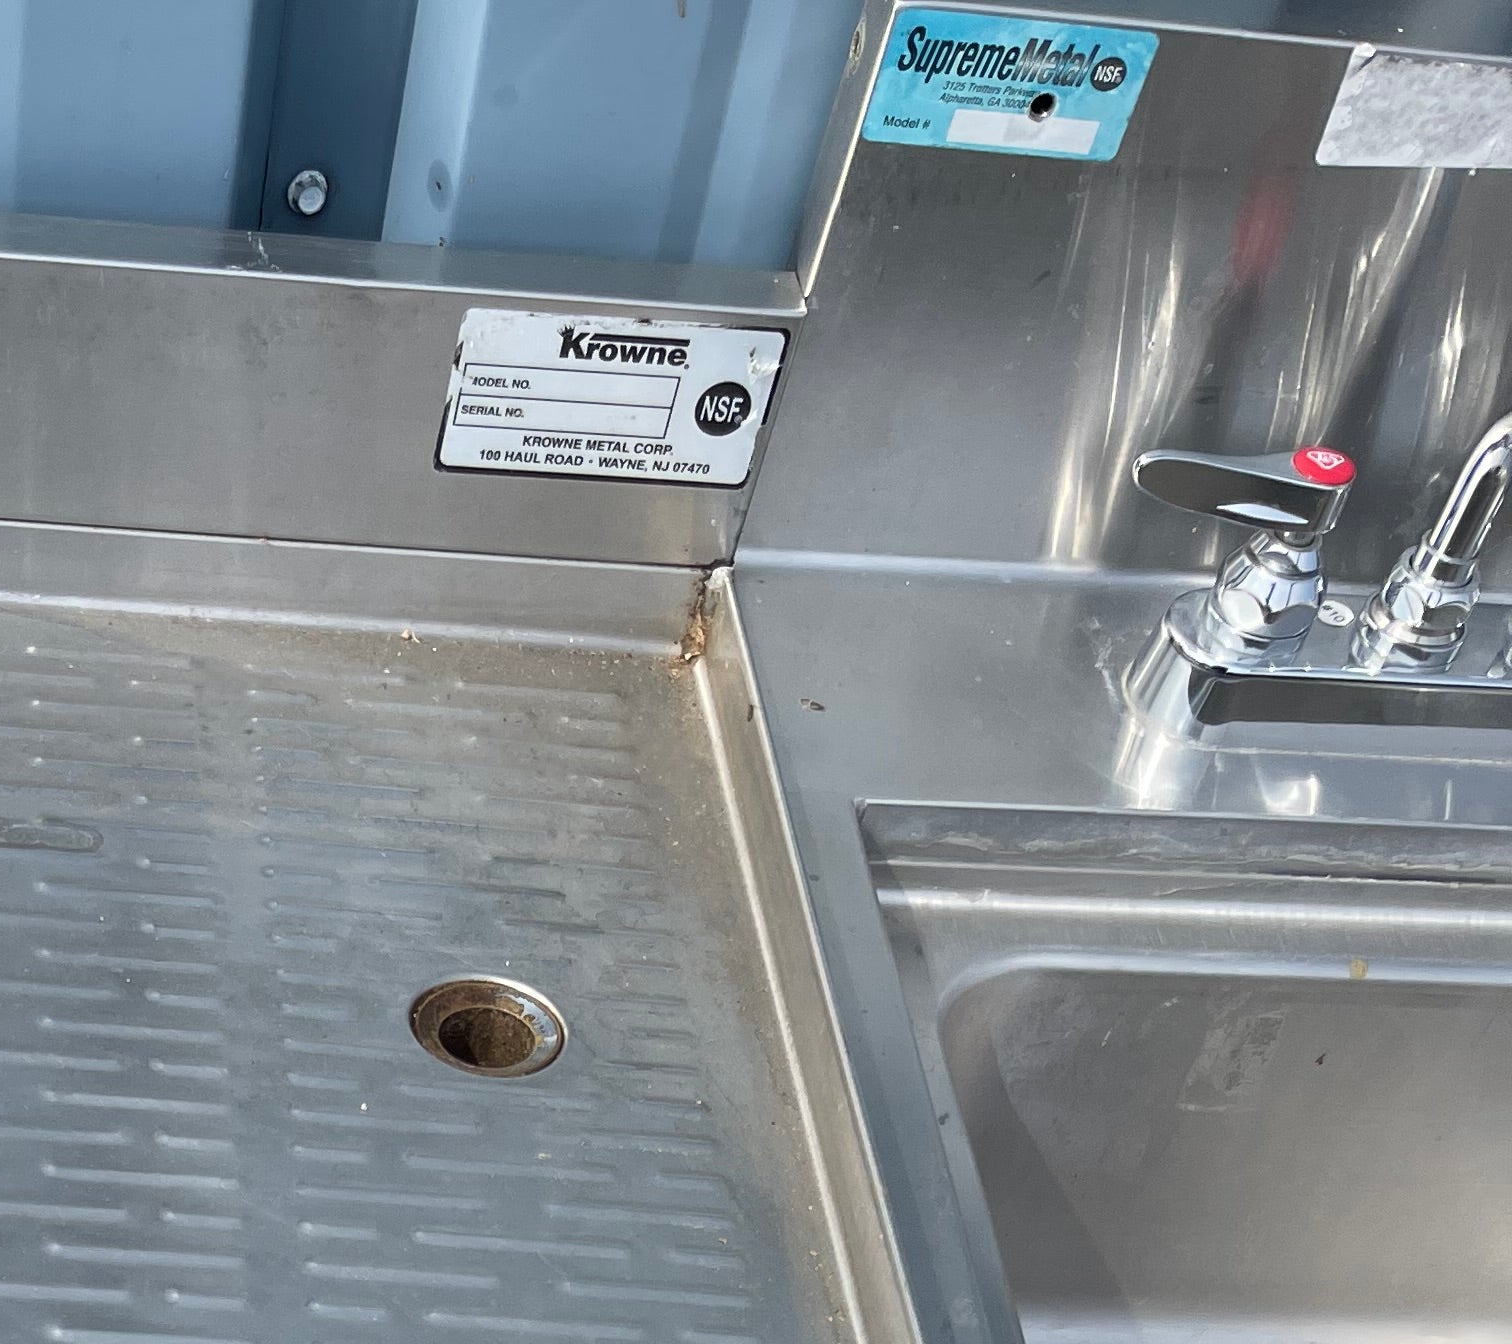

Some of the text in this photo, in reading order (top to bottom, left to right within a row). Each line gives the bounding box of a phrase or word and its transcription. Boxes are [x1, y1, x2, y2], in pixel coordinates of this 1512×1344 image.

[897, 26, 1102, 88] SupremeMetal
[1093, 65, 1124, 84] NSF
[942, 81, 966, 92] 3125
[1003, 85, 1039, 97] Parkwa
[987, 96, 1001, 107] GA
[883, 115, 920, 129] Model
[559, 331, 689, 367] Krowne
[461, 404, 525, 418] SERIAL NO.
[699, 395, 745, 423] NSF
[522, 435, 674, 456] KROWNE METAL CORP.
[480, 449, 710, 475] 100 HAUL ROAD WAYNE, NJ 07470
